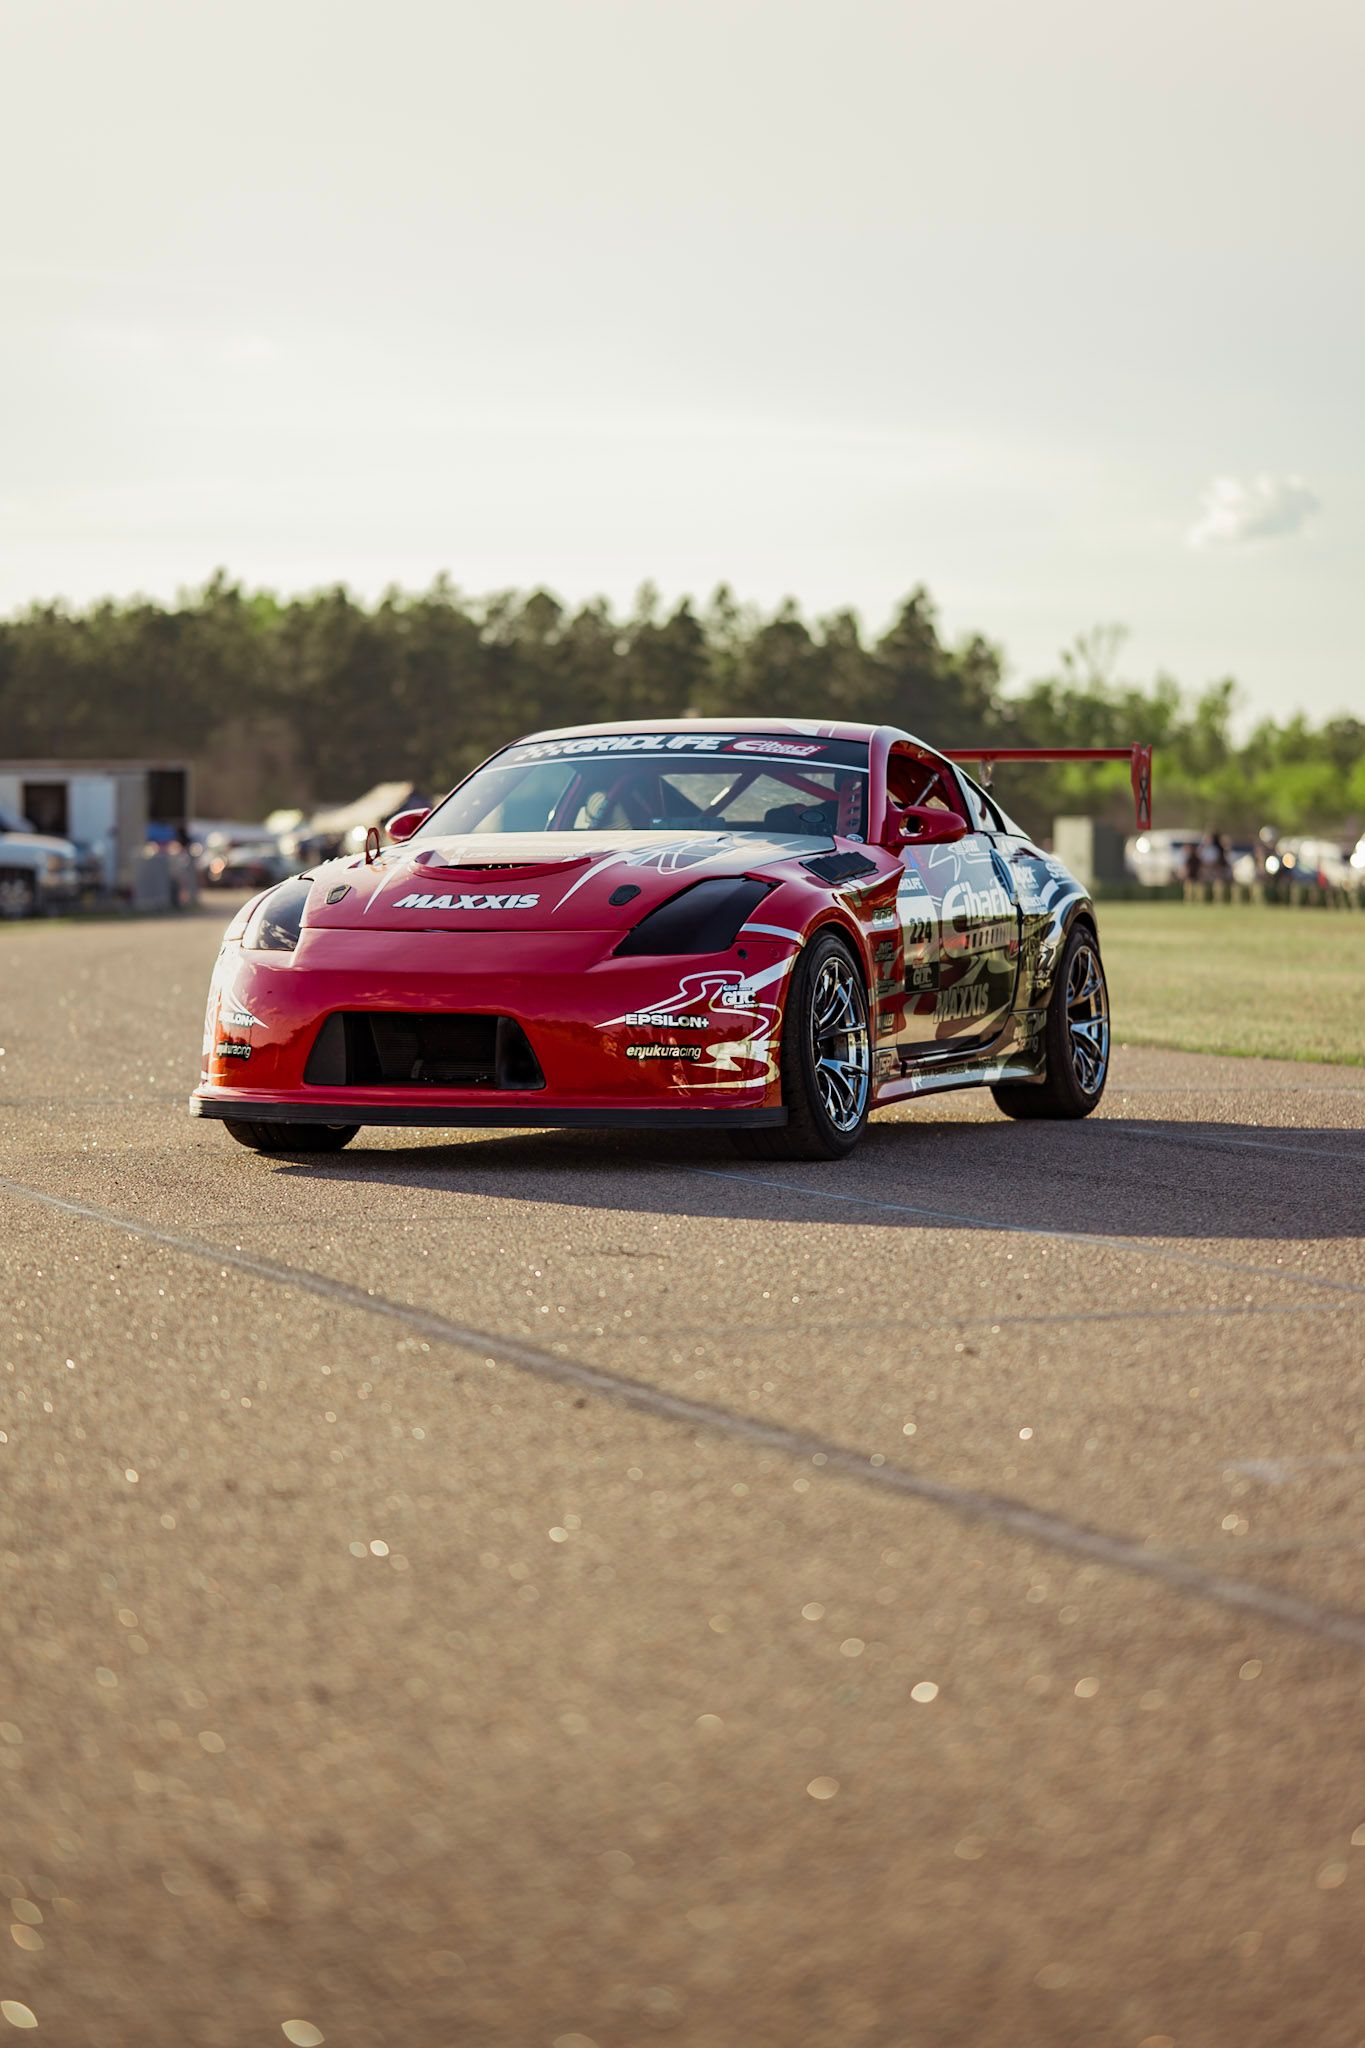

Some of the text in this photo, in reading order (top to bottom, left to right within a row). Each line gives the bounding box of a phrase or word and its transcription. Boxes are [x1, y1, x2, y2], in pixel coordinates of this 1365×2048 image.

[564, 735, 736, 754] GRIDLIFE
[392, 894, 541, 909] MAXXIS
[909, 917, 932, 944] 224
[933, 982, 989, 1024] MAXXIS
[625, 1013, 710, 1028] EPSILON+
[626, 1044, 702, 1060] enjukuracing
